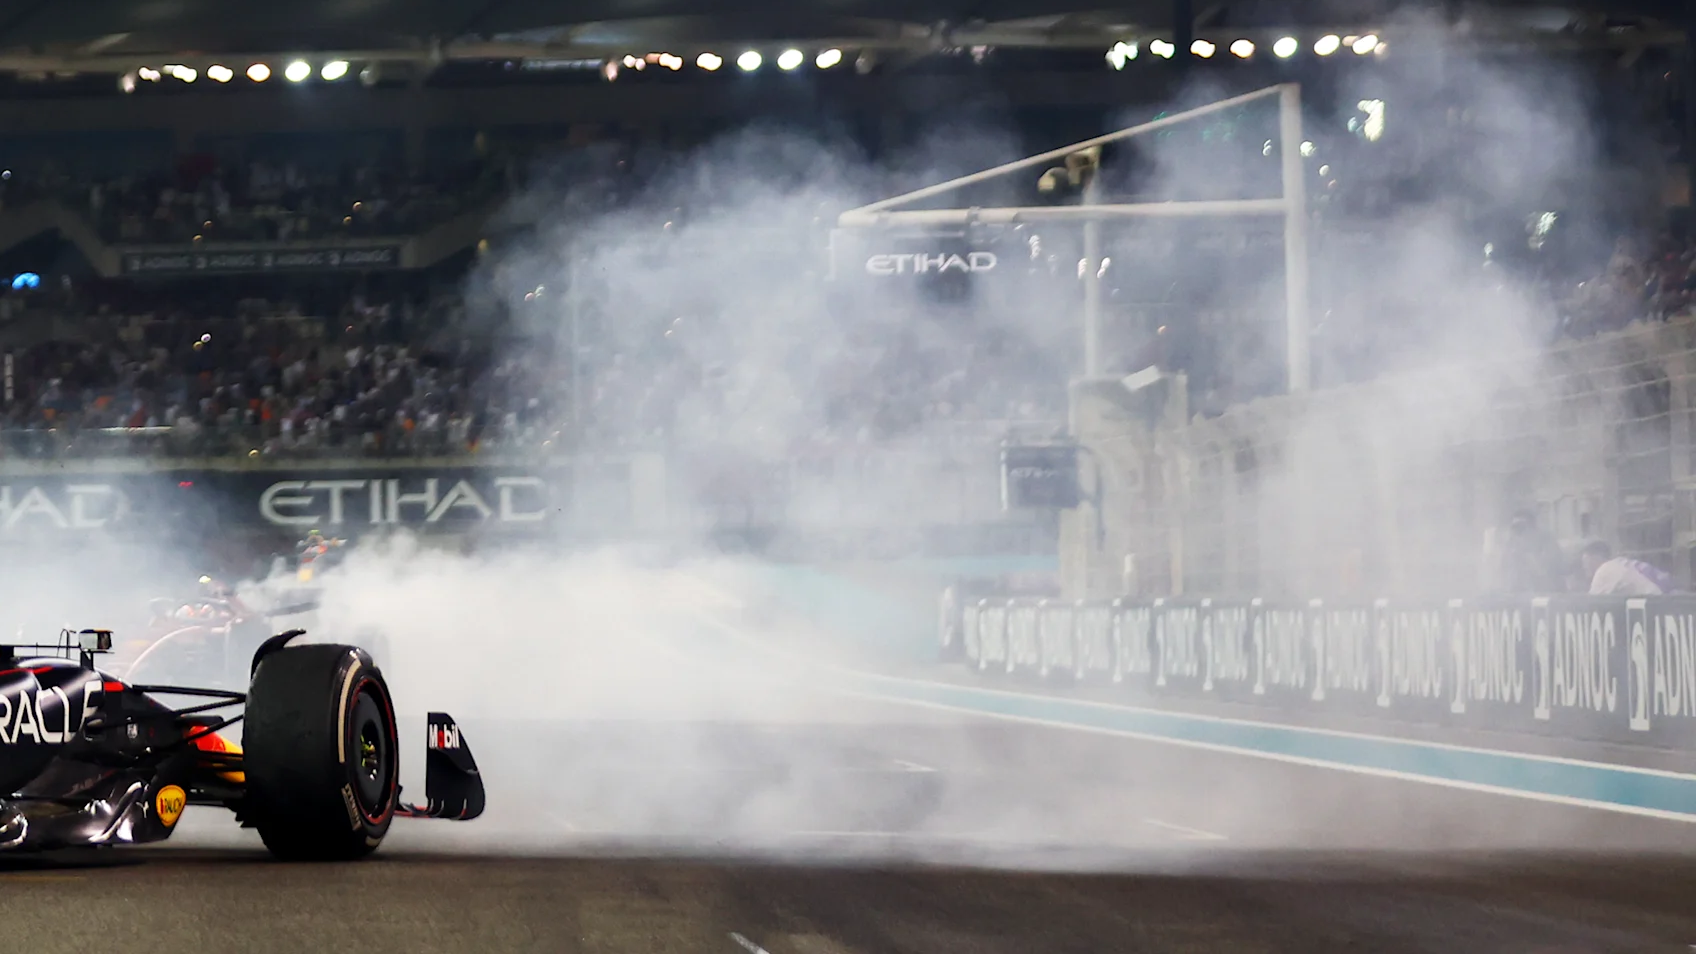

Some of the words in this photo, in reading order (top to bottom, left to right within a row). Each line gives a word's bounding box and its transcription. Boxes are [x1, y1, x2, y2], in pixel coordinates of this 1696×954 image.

[865, 251, 997, 275] ETIHAD
[259, 475, 549, 526] ETIHAD
[1467, 609, 1524, 704] ADNOC
[1553, 611, 1617, 713] ADNOC
[1653, 613, 1696, 718] ADN
[428, 724, 461, 749] Mobil
